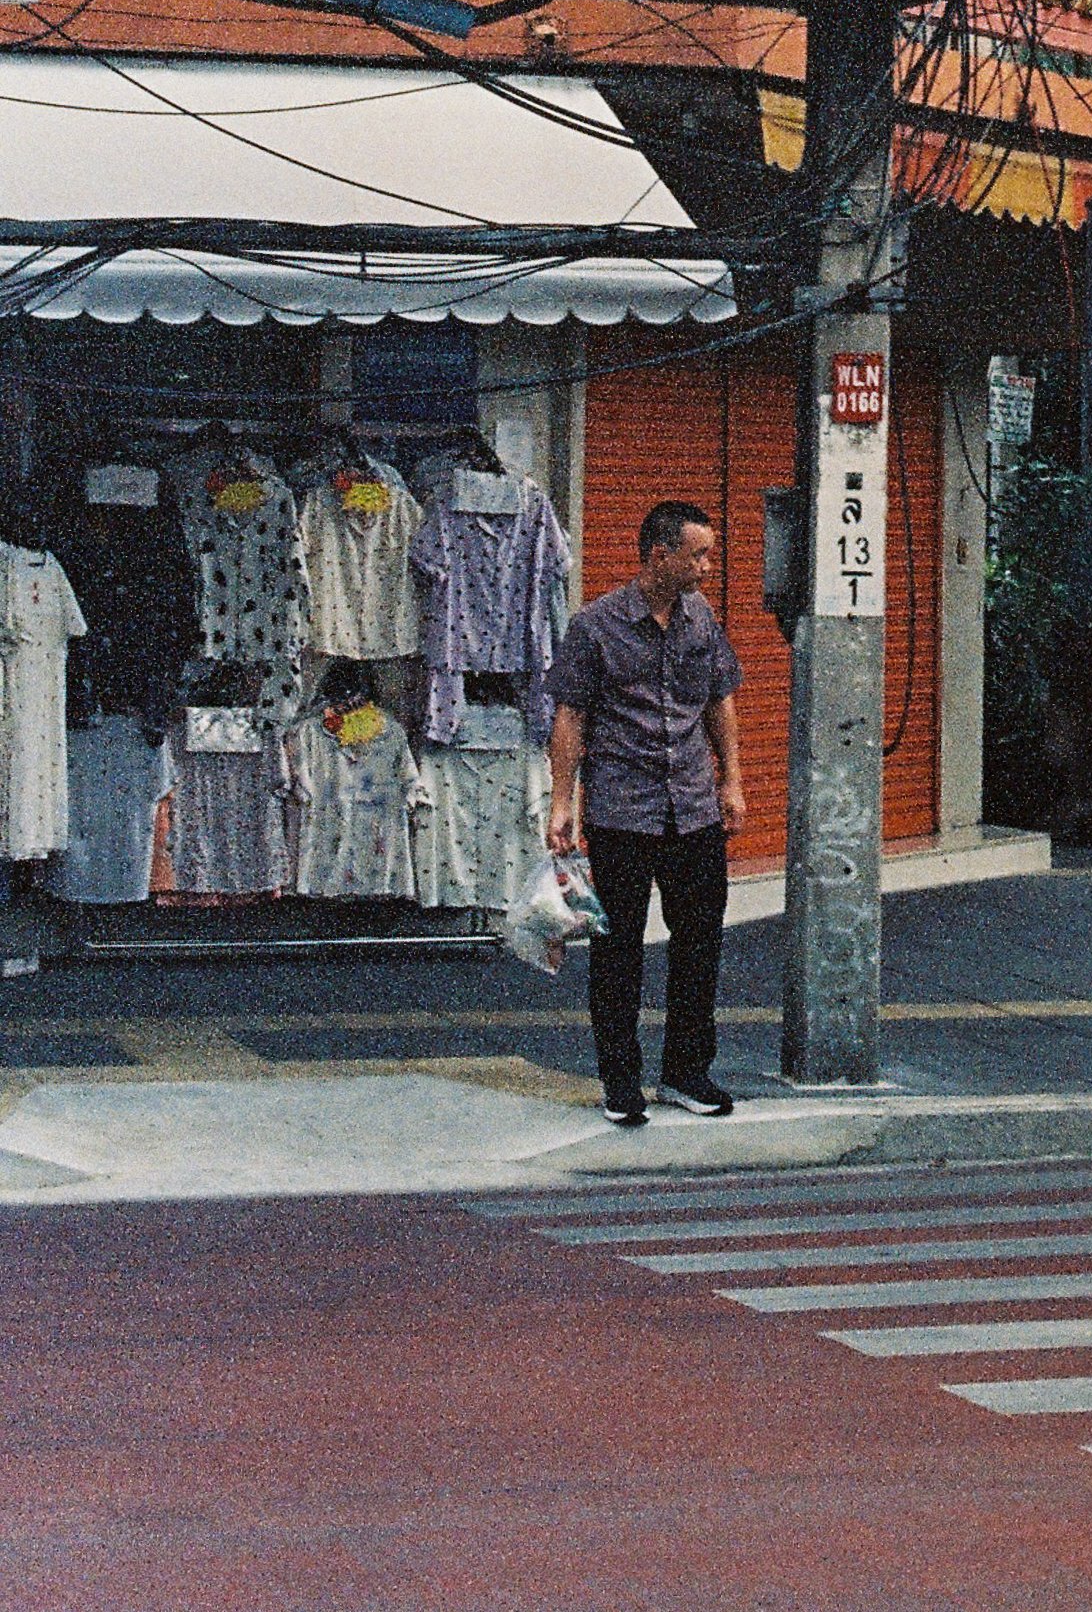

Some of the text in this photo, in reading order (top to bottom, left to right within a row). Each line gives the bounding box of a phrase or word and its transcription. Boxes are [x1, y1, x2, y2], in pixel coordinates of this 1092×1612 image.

[838, 364, 880, 386] WLN
[837, 391, 880, 413] 0166
[837, 535, 871, 566] 13
[848, 578, 858, 607] 1
